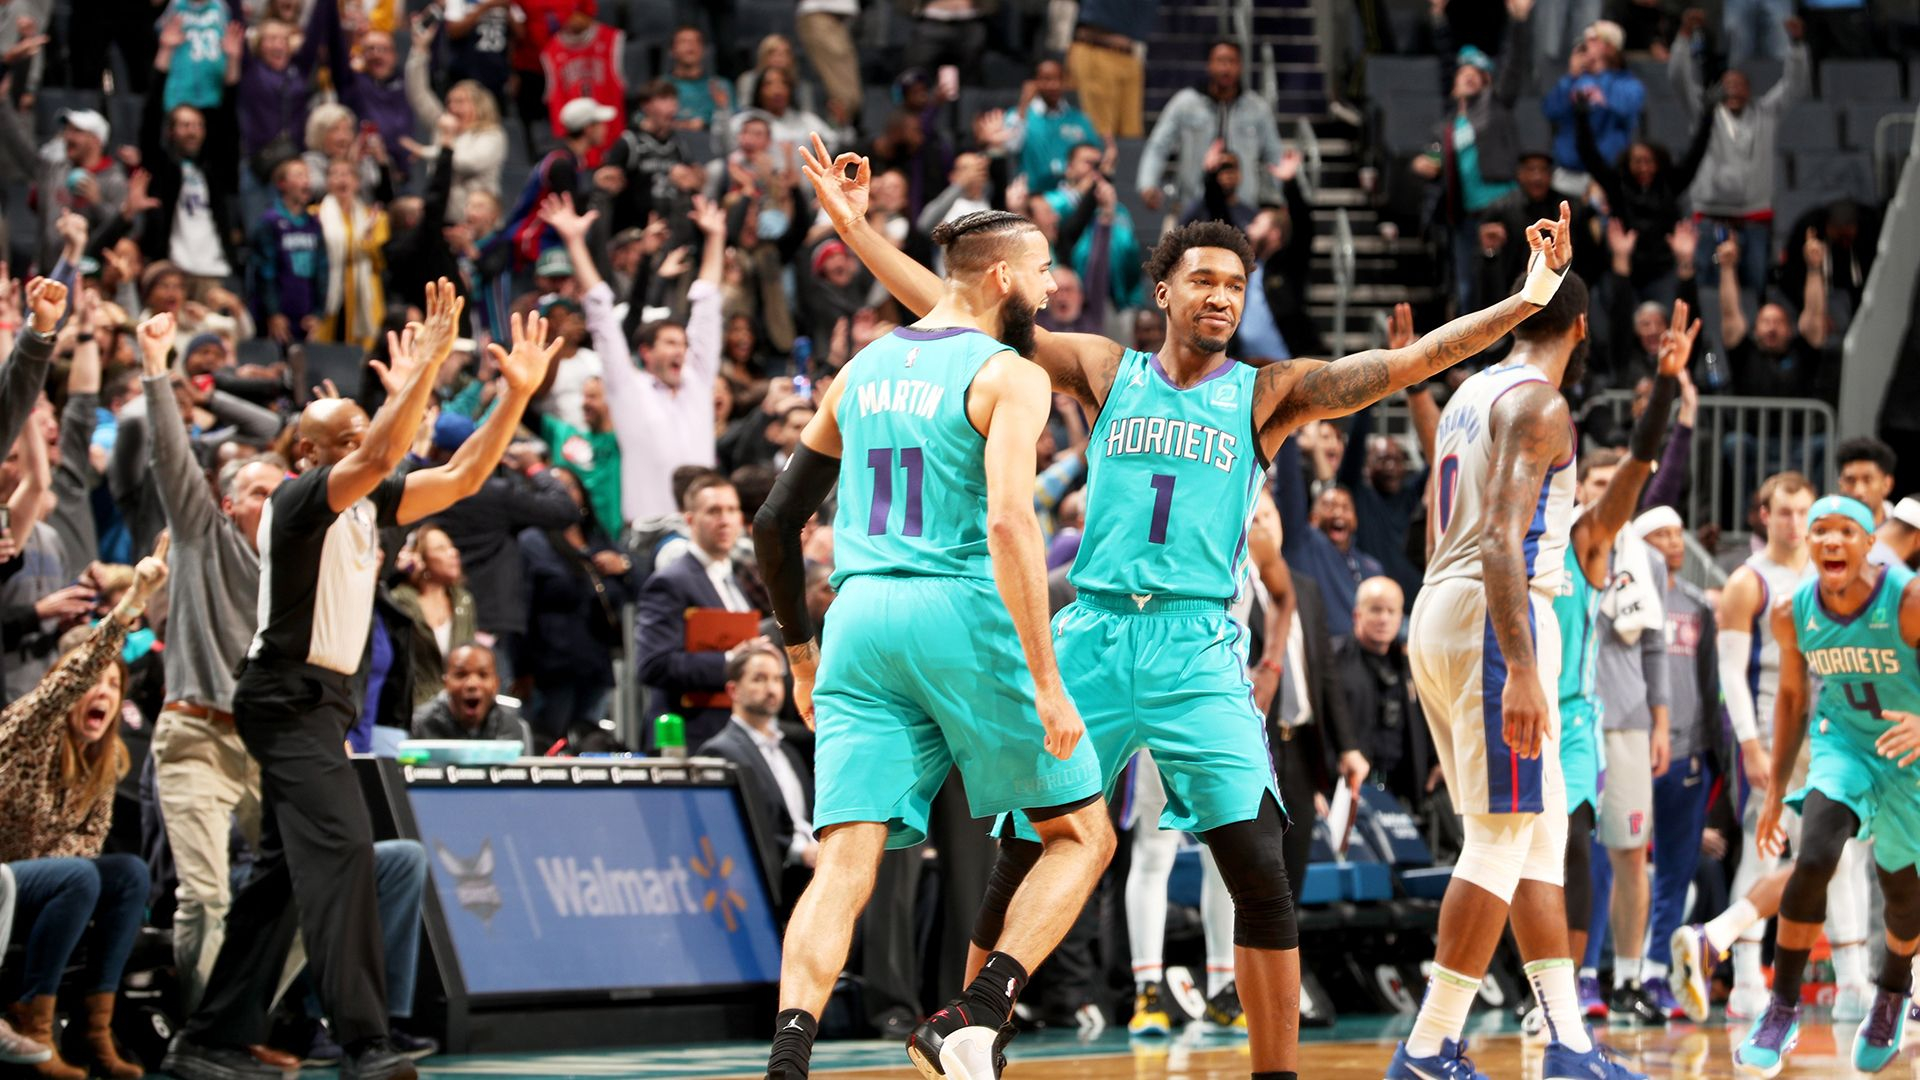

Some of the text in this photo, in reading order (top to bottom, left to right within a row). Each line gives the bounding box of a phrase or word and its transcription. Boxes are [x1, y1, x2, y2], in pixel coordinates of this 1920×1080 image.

[857, 379, 945, 420] MARTIN
[1104, 416, 1238, 474] HORNETS
[867, 447, 924, 537] 11
[1148, 473, 1177, 545] 1
[1805, 646, 1900, 675] HORNETS
[1842, 682, 1883, 720] 4
[535, 856, 699, 918] Walmart
